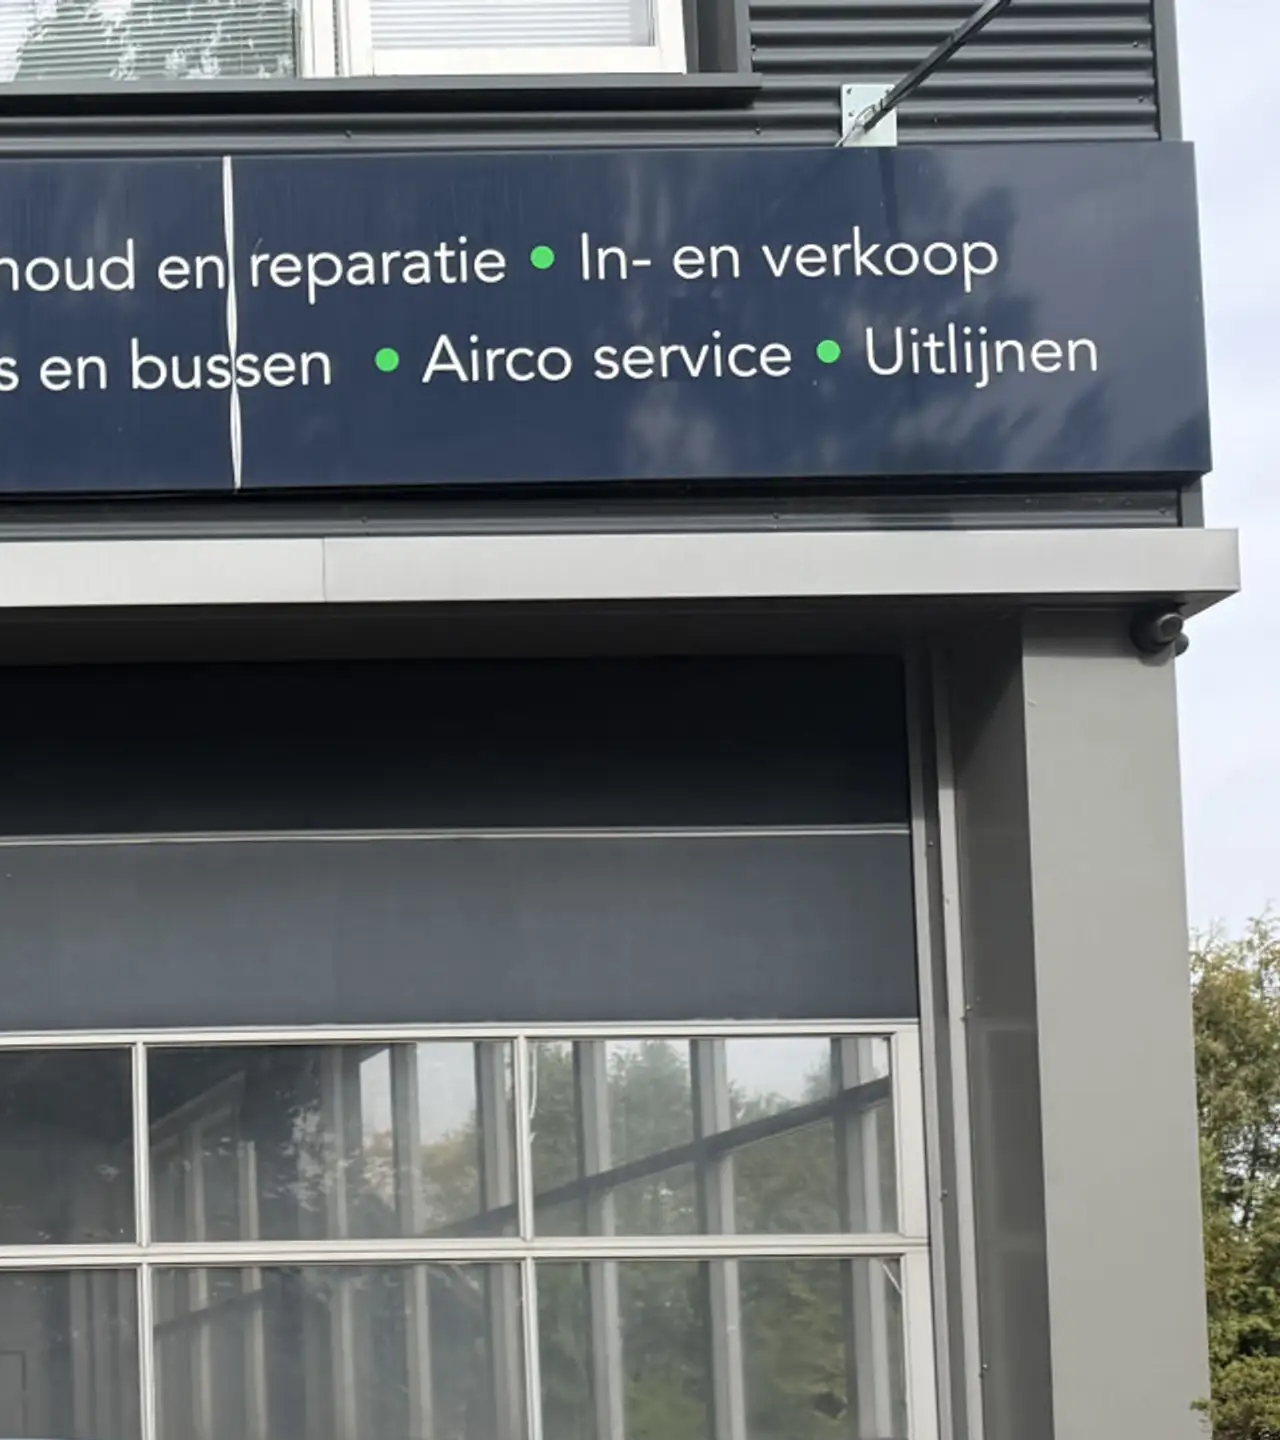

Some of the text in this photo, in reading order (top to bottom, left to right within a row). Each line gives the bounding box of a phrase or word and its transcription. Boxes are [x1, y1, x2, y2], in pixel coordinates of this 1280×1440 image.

[157, 255, 225, 291] en
[251, 236, 507, 305] reparatie
[581, 232, 652, 281] In-
[673, 245, 740, 280] en
[761, 225, 999, 293] verkoop
[39, 355, 107, 391] en
[131, 337, 332, 390] bussen
[422, 333, 572, 383] Airco
[594, 330, 792, 380] service
[865, 322, 1098, 389] Uitlijnen
